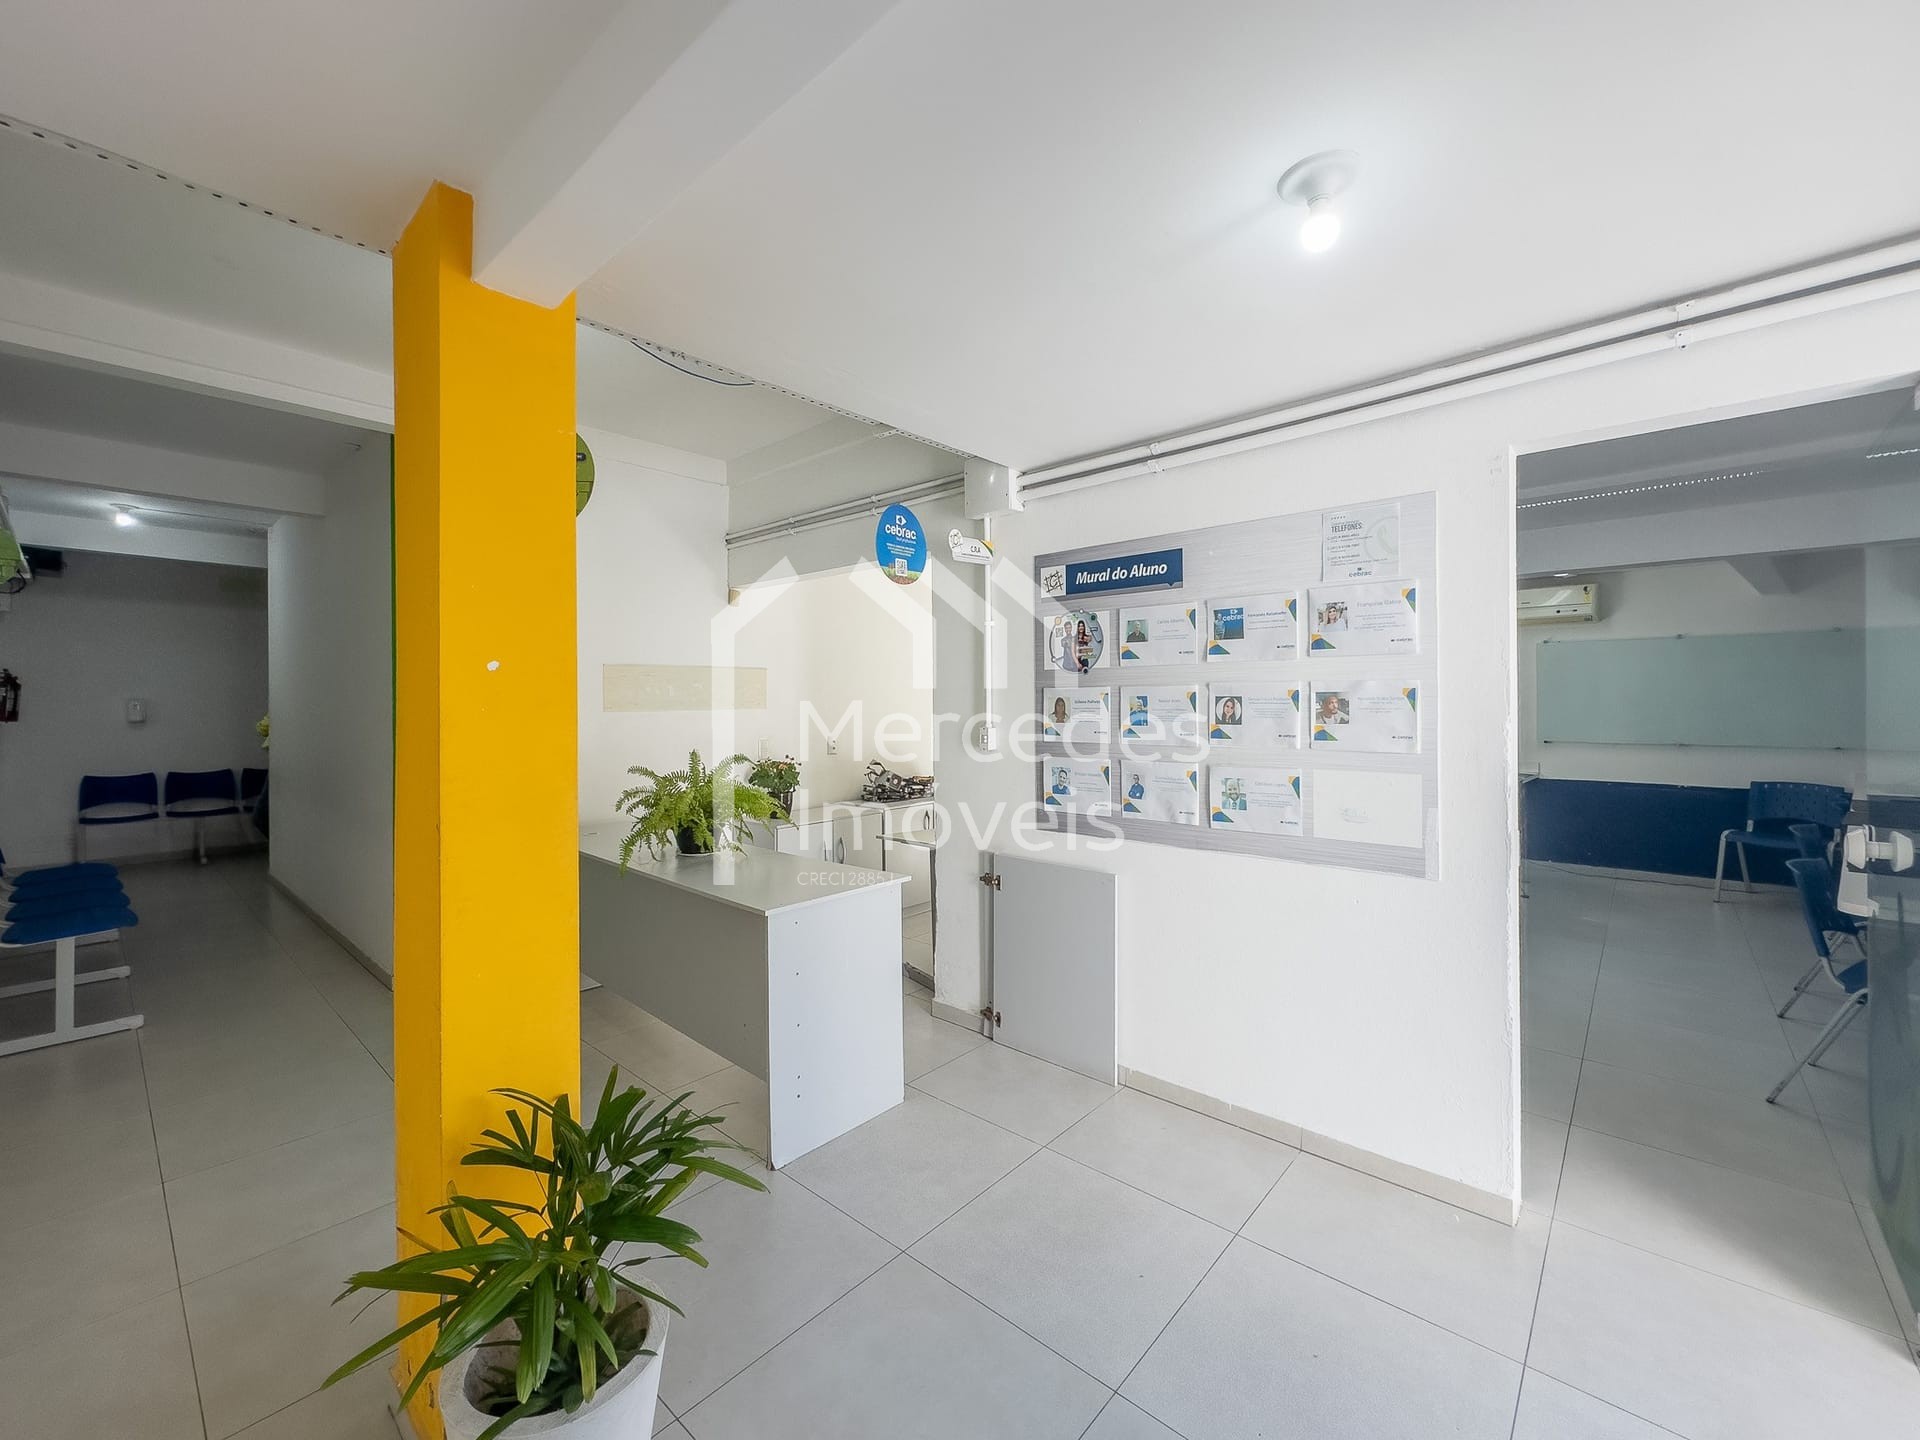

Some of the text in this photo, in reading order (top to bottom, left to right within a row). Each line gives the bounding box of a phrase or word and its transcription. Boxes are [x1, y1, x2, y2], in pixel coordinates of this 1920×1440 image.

[884, 524, 917, 540] cebrac
[1331, 521, 1363, 533] TELEFONES
[1076, 563, 1168, 585] Mural do Aluno
